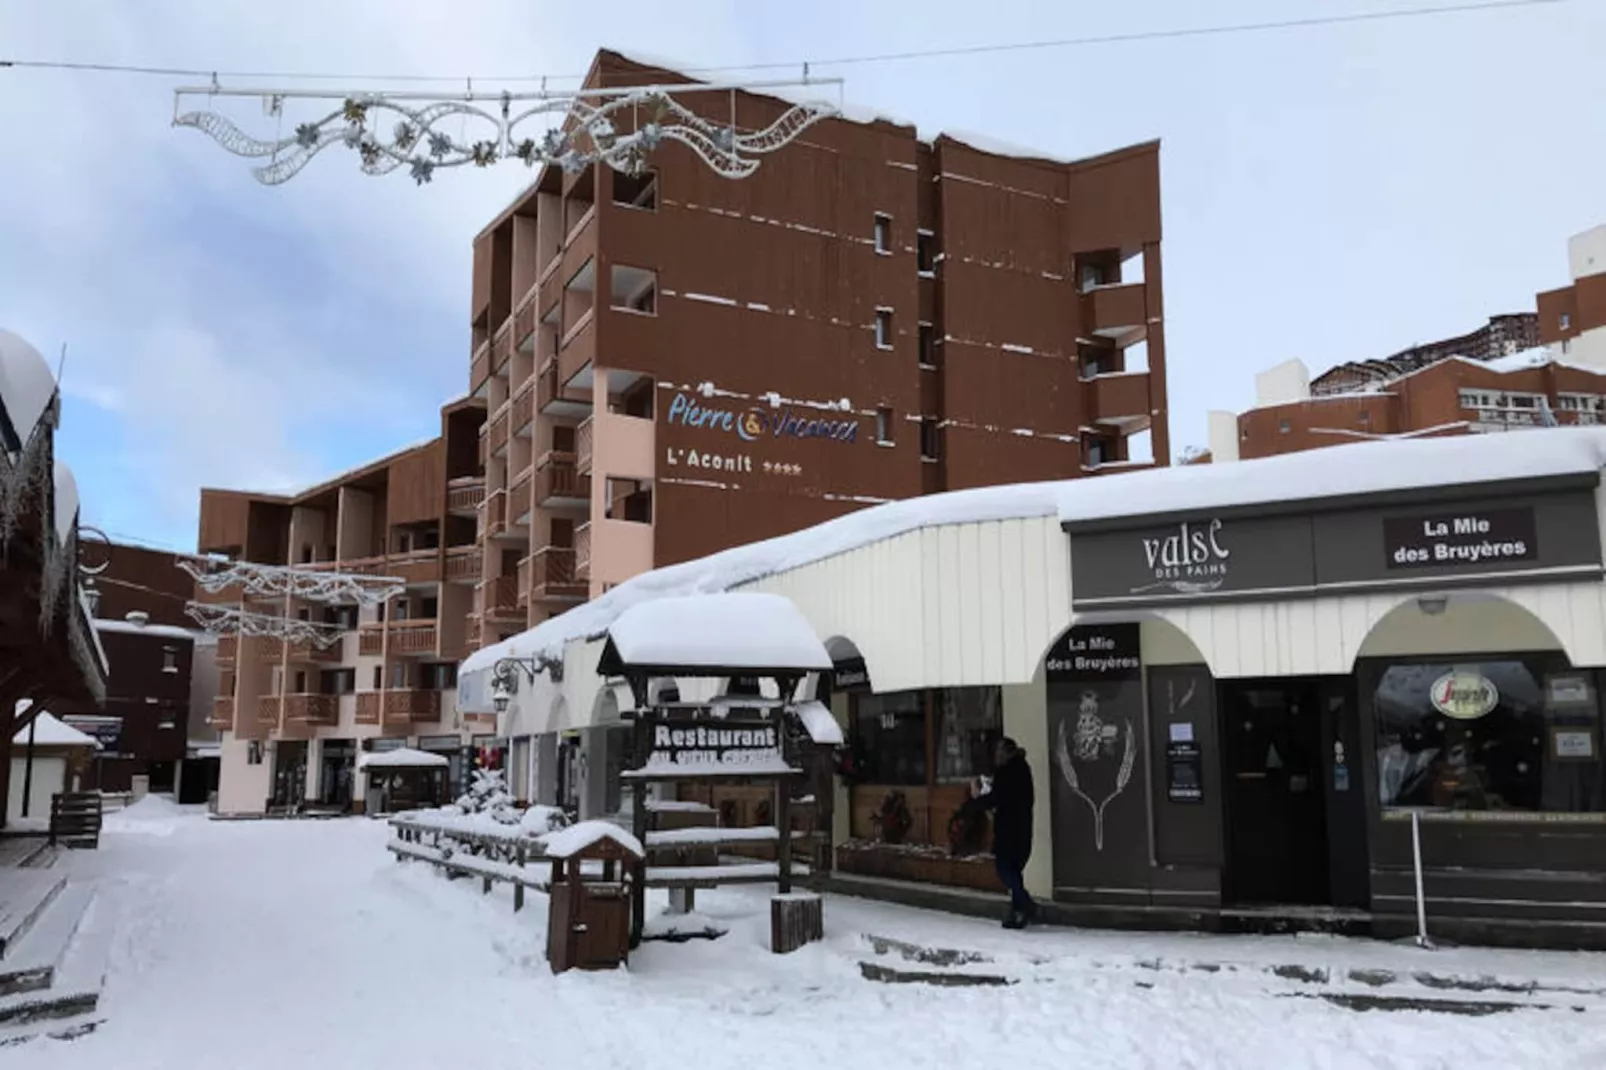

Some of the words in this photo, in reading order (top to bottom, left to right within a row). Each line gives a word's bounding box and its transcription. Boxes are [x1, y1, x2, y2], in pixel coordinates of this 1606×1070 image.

[667, 392, 734, 432] Pierre
[744, 413, 761, 435] &
[772, 409, 859, 443] Vacances
[1423, 520, 1449, 537] La
[1453, 517, 1491, 535] Mie
[1394, 546, 1429, 563] des
[1434, 540, 1527, 562] Bruyères
[1155, 566, 1180, 579] DES
[1187, 562, 1227, 577] PAINS
[1069, 637, 1087, 651] La
[1089, 635, 1116, 650] Mie
[1047, 657, 1072, 671] des
[1075, 655, 1139, 673] Bruyères
[655, 724, 776, 747] Restaurant
